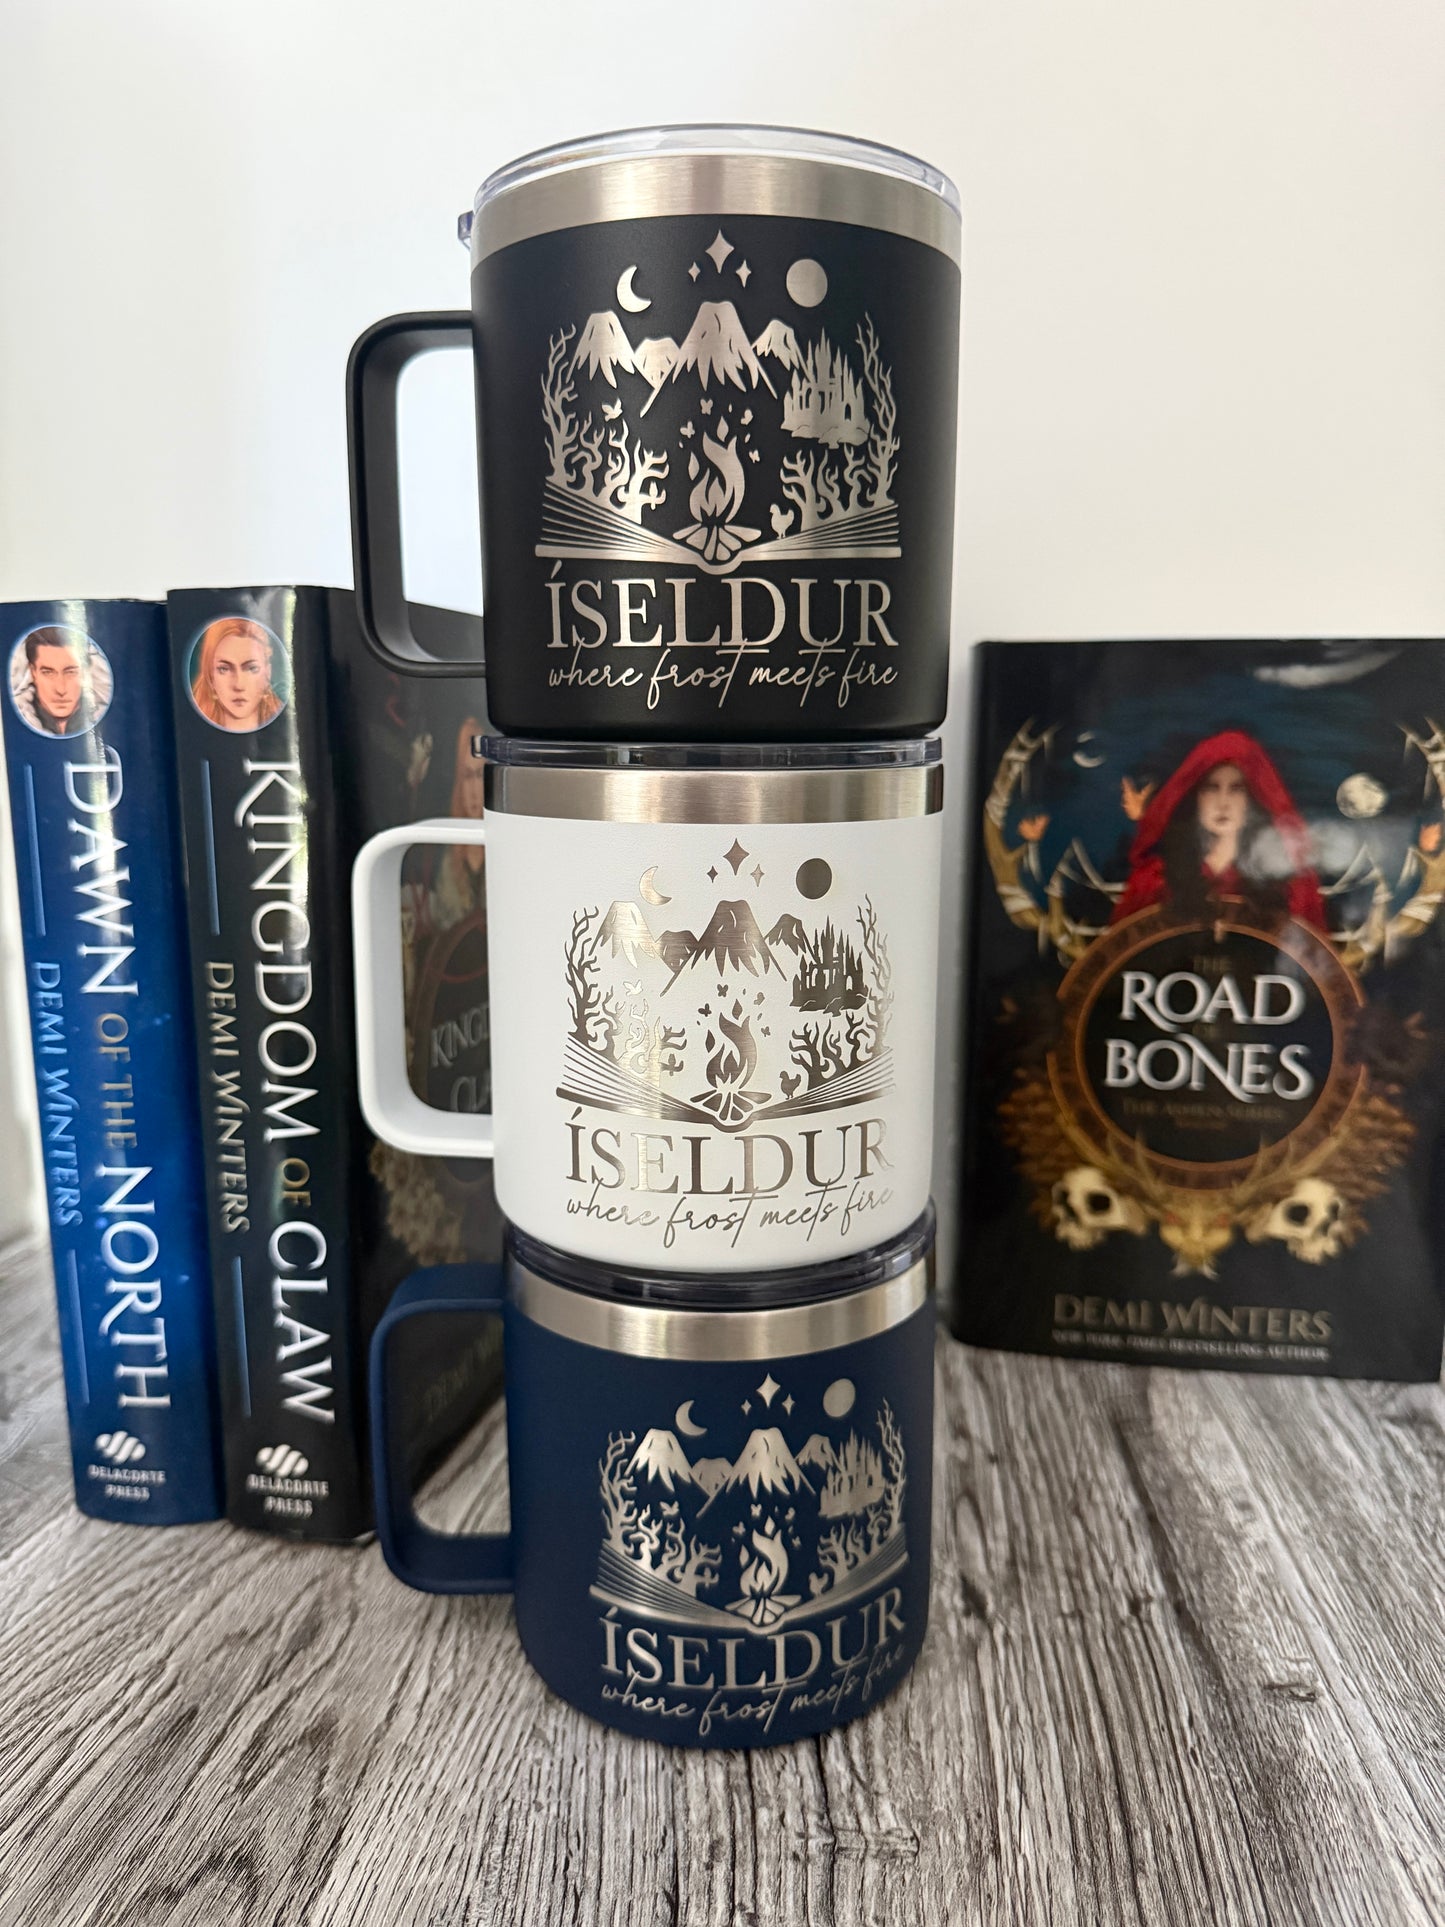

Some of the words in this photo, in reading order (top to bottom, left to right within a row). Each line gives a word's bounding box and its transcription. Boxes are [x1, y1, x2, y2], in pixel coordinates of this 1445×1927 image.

[545, 559, 899, 649] ÍSELDUR
[548, 637, 644, 688] where
[646, 637, 770, 711] frost
[748, 637, 847, 709] meets
[838, 647, 900, 709] fire
[64, 744, 139, 997] DAWN
[234, 757, 321, 1144] KINGDOM
[31, 961, 68, 1056] DEMI
[97, 1012, 133, 1065] OF
[205, 960, 242, 1058] DEMI
[1118, 970, 1307, 1034] ROAD
[1103, 1032, 1315, 1104] BONES
[41, 1067, 84, 1228] WINTERS
[101, 1073, 138, 1150] THE
[211, 1068, 251, 1236] WINTERS
[280, 1156, 313, 1208] OF
[564, 1106, 896, 1196] ÍSELDUR
[566, 1176, 661, 1228] where
[662, 1186, 779, 1248] frost
[759, 1178, 848, 1242] meets
[838, 1180, 895, 1236] fire
[96, 1164, 171, 1409] NORTH
[268, 1219, 336, 1425] CLAW
[1053, 1293, 1152, 1330] DEMI
[1160, 1297, 1333, 1345] WINTERS
[88, 1464, 166, 1485] DELACORTE
[104, 1483, 150, 1501] PRESS
[246, 1473, 330, 1498] DELACORTE
[264, 1495, 313, 1518] PRESS
[600, 1586, 906, 1691] ÍSELDUR
[601, 1671, 696, 1719] where
[699, 1677, 808, 1736] frost
[789, 1656, 868, 1715] meets
